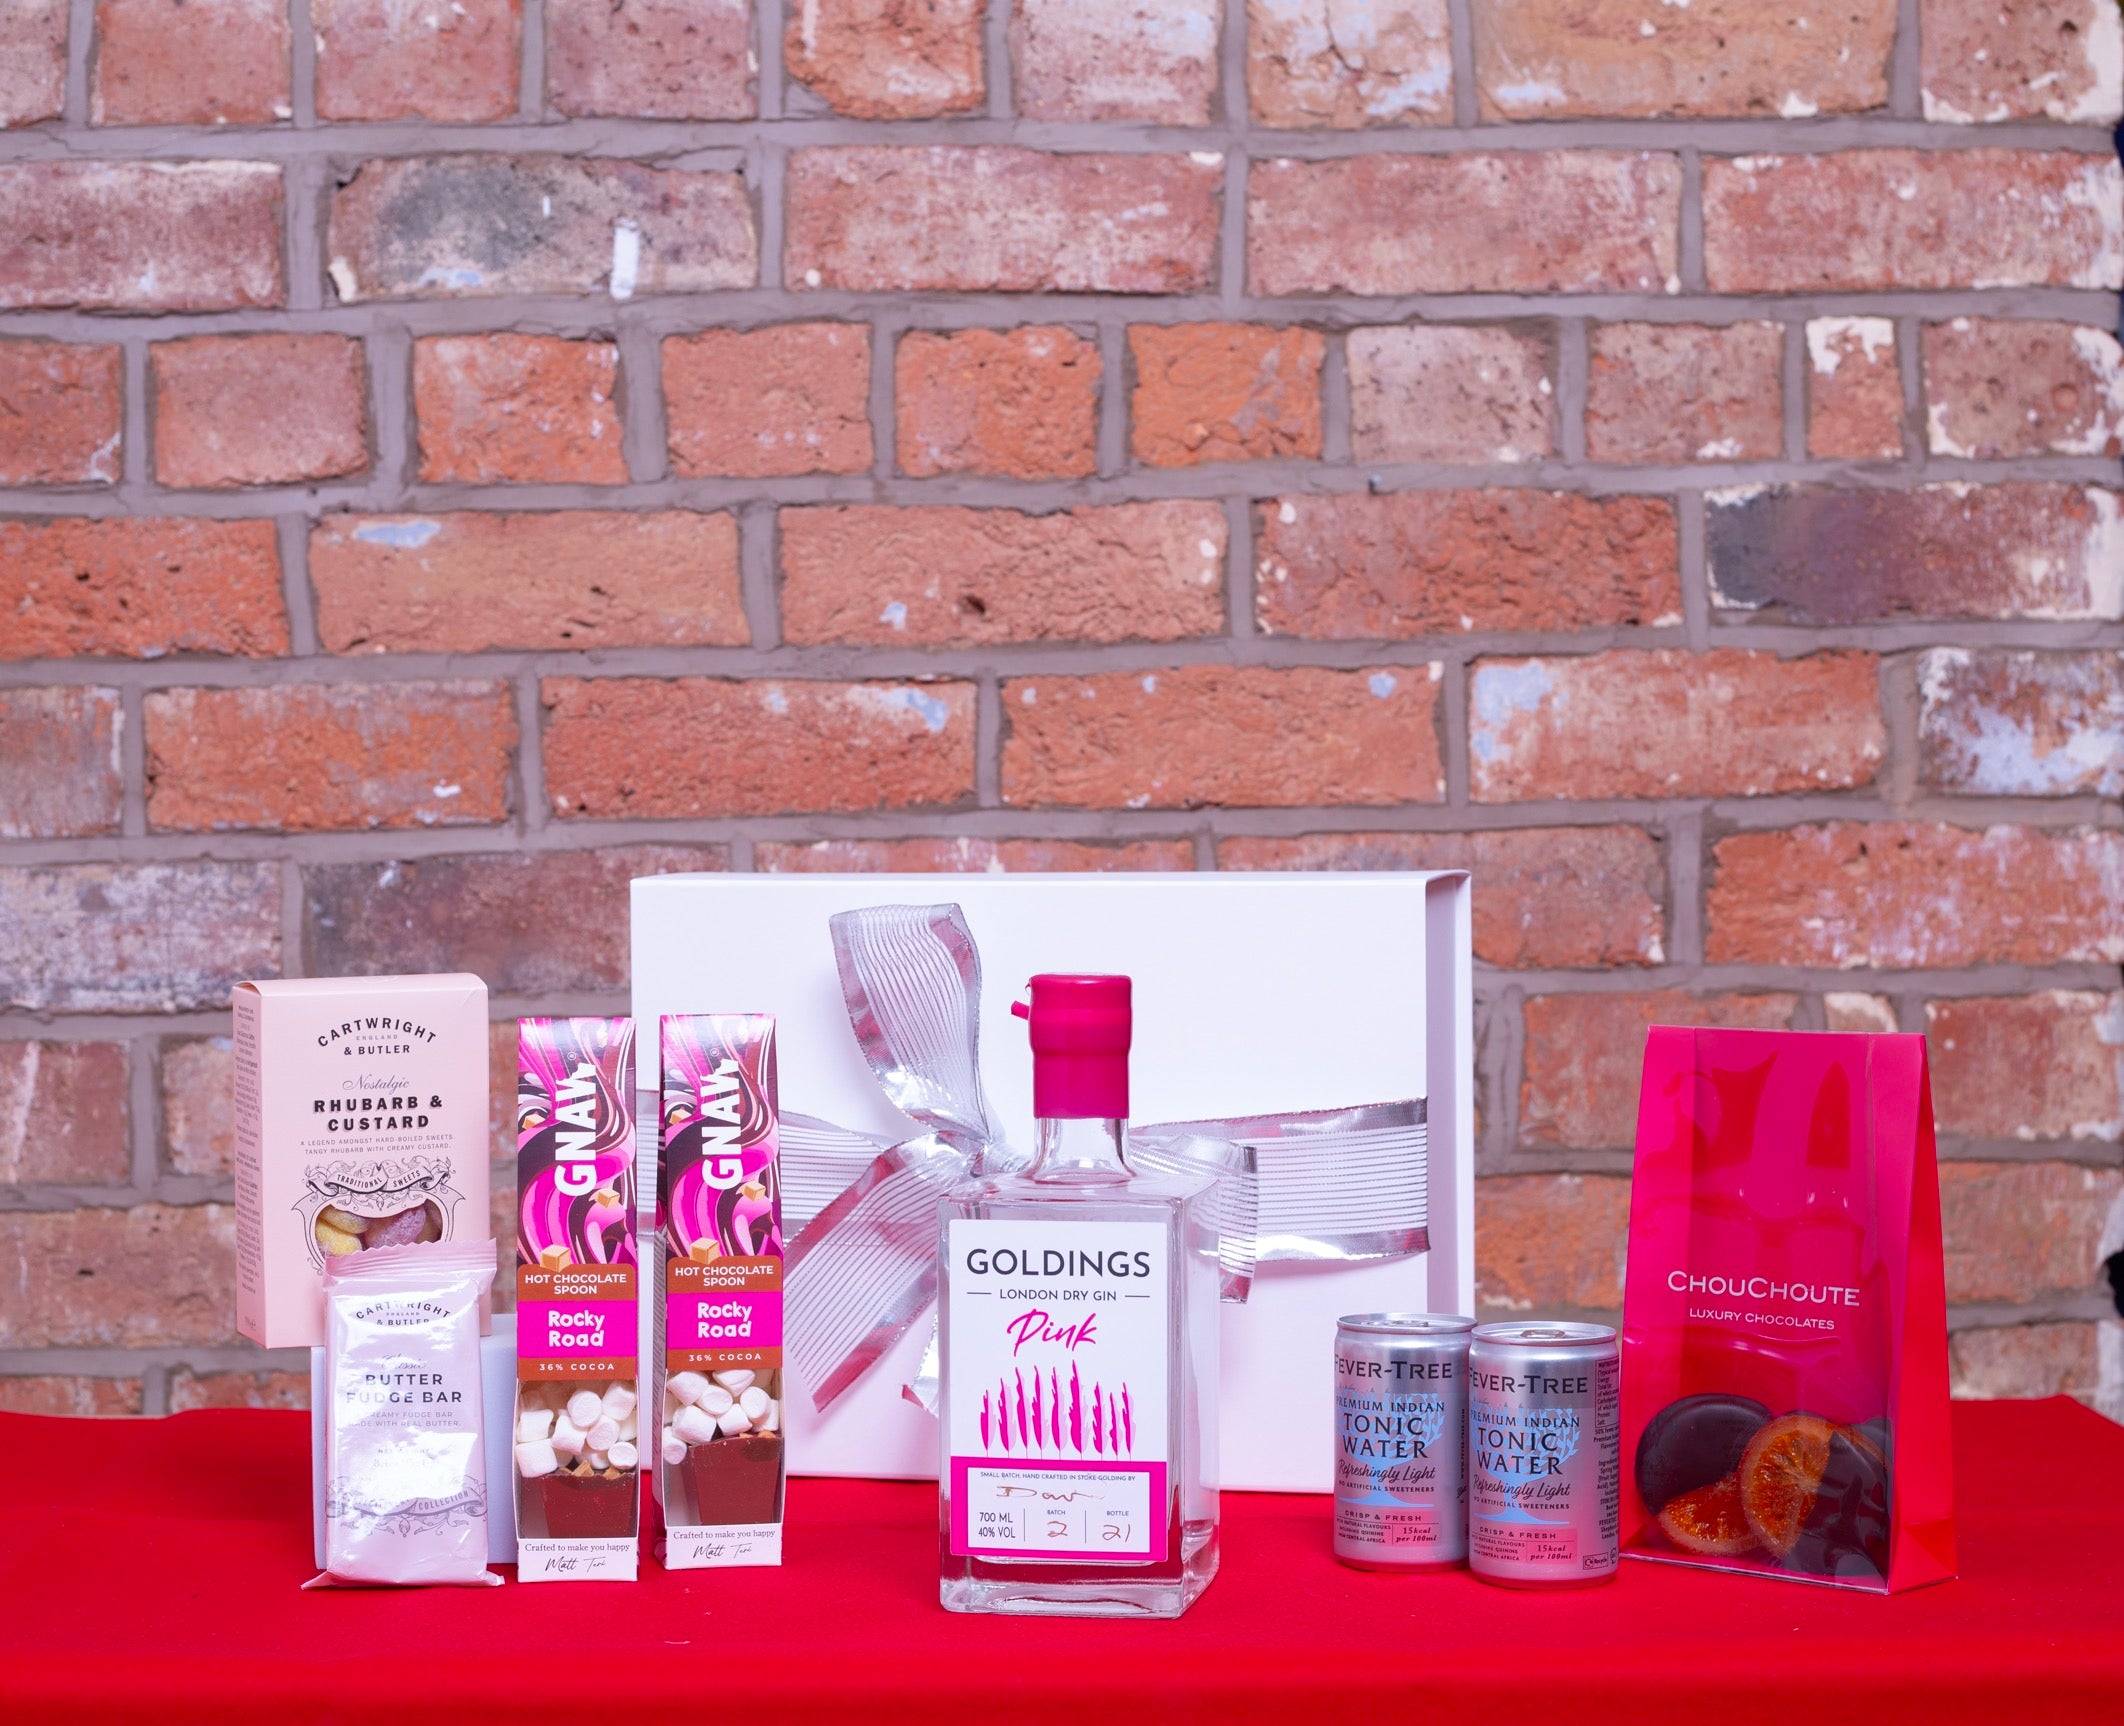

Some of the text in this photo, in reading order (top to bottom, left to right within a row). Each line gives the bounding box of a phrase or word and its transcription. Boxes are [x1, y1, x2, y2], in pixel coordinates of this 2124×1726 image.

[318, 1017, 437, 1047] CARTWRIGHT
[344, 1045, 410, 1055] & BUTLER
[342, 1074, 410, 1095] Nostalgic
[314, 1095, 443, 1113] RHUBARB &
[328, 1115, 429, 1132] CUSTARD
[555, 1062, 597, 1197] GNAW
[701, 1058, 743, 1190] GNAW
[336, 1169, 421, 1189] TRADITIONAL SWEETS
[966, 1248, 1150, 1278] GOLDINGS
[675, 1265, 774, 1276] HOT CHOCOLATE
[525, 1273, 627, 1284] HOT CHOCOLATE
[703, 1277, 745, 1288] SPOON
[554, 1285, 597, 1295] SPOON
[1000, 1288, 1117, 1301] LONDON DRY GIN
[356, 1301, 451, 1319] CARTRIGHT
[697, 1301, 752, 1322] Rocky
[548, 1310, 605, 1331] Rocky
[1689, 1308, 1835, 1330] LUXURY CHOCOLATES
[697, 1321, 752, 1339] Road
[1006, 1308, 1097, 1357] Pink
[549, 1330, 604, 1347] Road
[689, 1353, 761, 1362] 36% COCOA
[539, 1363, 614, 1371] 36% COCOA
[365, 1374, 443, 1385] BUTTER
[422, 1391, 462, 1403] BAR
[1391, 1402, 1444, 1412] INDIAN
[1344, 1412, 1424, 1436] TONIC
[1525, 1417, 1579, 1427] INDIAN
[1478, 1427, 1557, 1451] TONIC
[1343, 1435, 1428, 1459] WATER
[1477, 1450, 1563, 1475] WATER
[1338, 1459, 1435, 1484] Refreshingly Light
[1346, 1482, 1382, 1491] ARTIFICIAL
[1473, 1474, 1571, 1500] Refreshingly Light
[418, 1491, 469, 1511] COLLECTION
[1481, 1497, 1516, 1508] ARTIFICIAL
[979, 1512, 1013, 1523] 700 ML
[1345, 1510, 1370, 1519] CRISP
[1047, 1520, 1068, 1538] 2
[1344, 1520, 1362, 1528] NATURAL
[1363, 1521, 1391, 1530] FLAVOURS
[1480, 1526, 1504, 1535] CRISP
[673, 1531, 703, 1539] Crafted
[753, 1530, 776, 1538] happy
[978, 1527, 1016, 1539] 40% VOL
[1346, 1533, 1365, 1542] CENTRAL
[1361, 1529, 1384, 1537] QUININE
[525, 1543, 555, 1551] Crafted
[568, 1543, 588, 1551] make
[607, 1543, 630, 1551] happy
[1479, 1536, 1496, 1545] NATURAL
[1497, 1539, 1525, 1547] FLAVOURS
[693, 1543, 725, 1559] Matt
[1481, 1551, 1499, 1559] CENTRAL
[1495, 1546, 1518, 1554] QUININE
[545, 1556, 579, 1572] Matt
